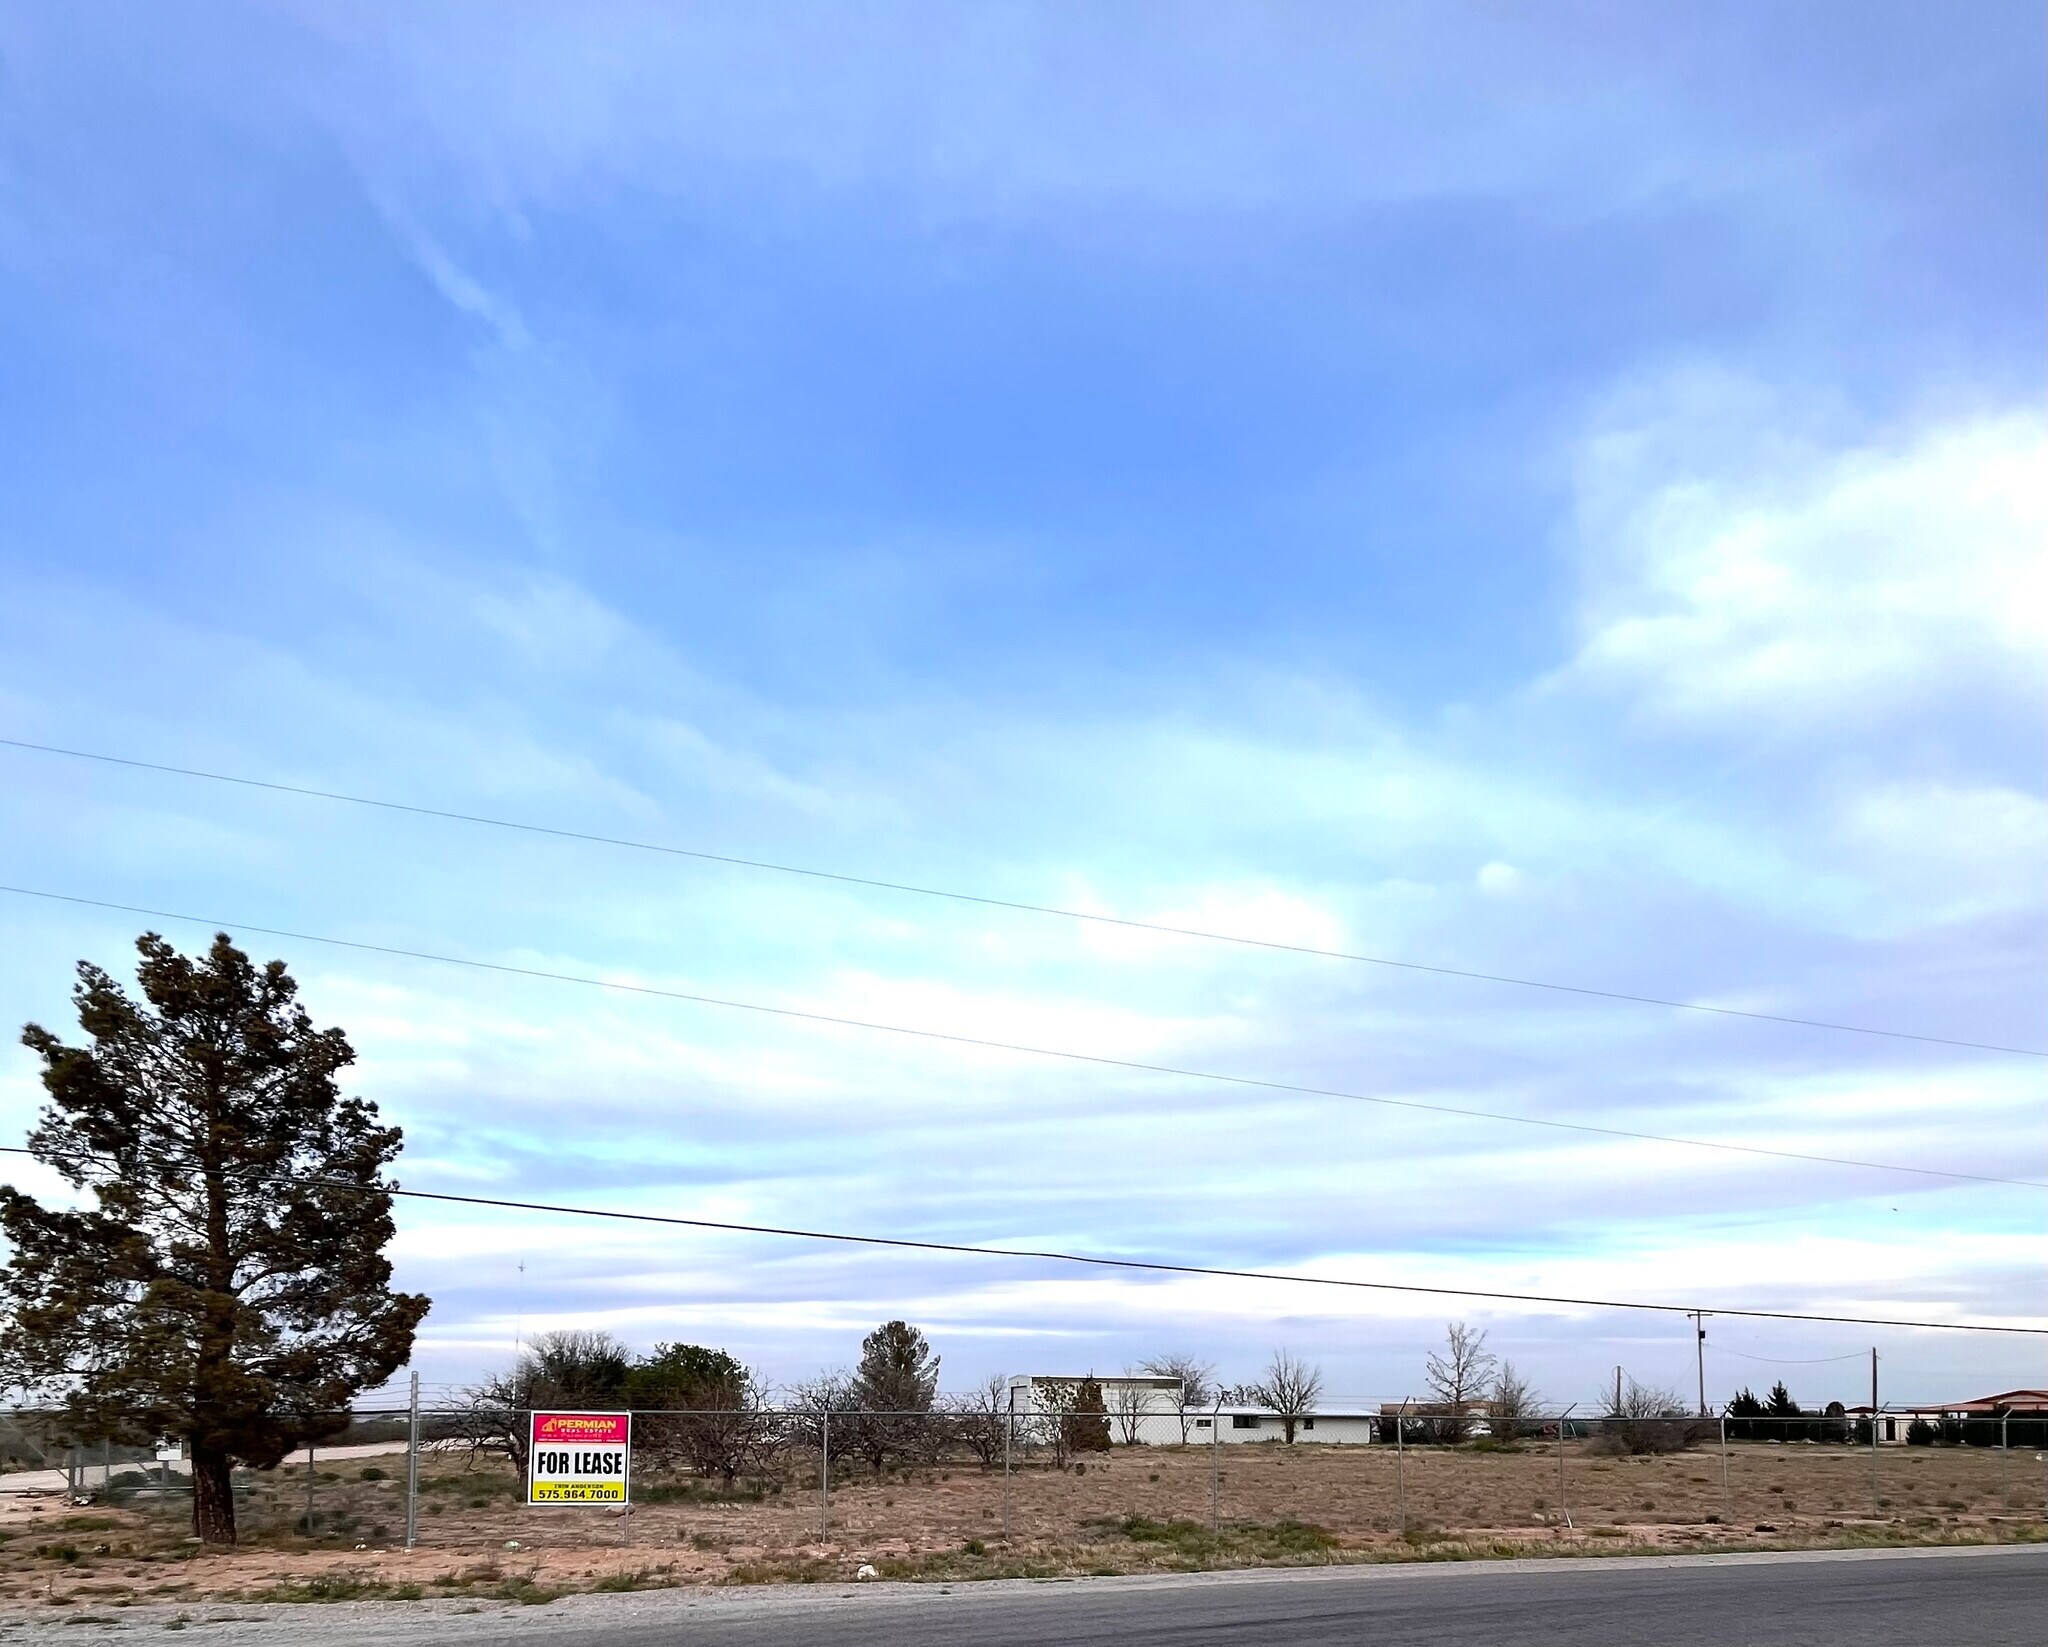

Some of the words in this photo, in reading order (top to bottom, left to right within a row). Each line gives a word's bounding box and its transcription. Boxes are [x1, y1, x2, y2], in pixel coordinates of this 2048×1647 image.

[557, 1419, 617, 1429] PERMIAN
[537, 1451, 570, 1474] FOR
[574, 1452, 623, 1475] LEASE
[538, 1489, 619, 1499] 575.964.7000
